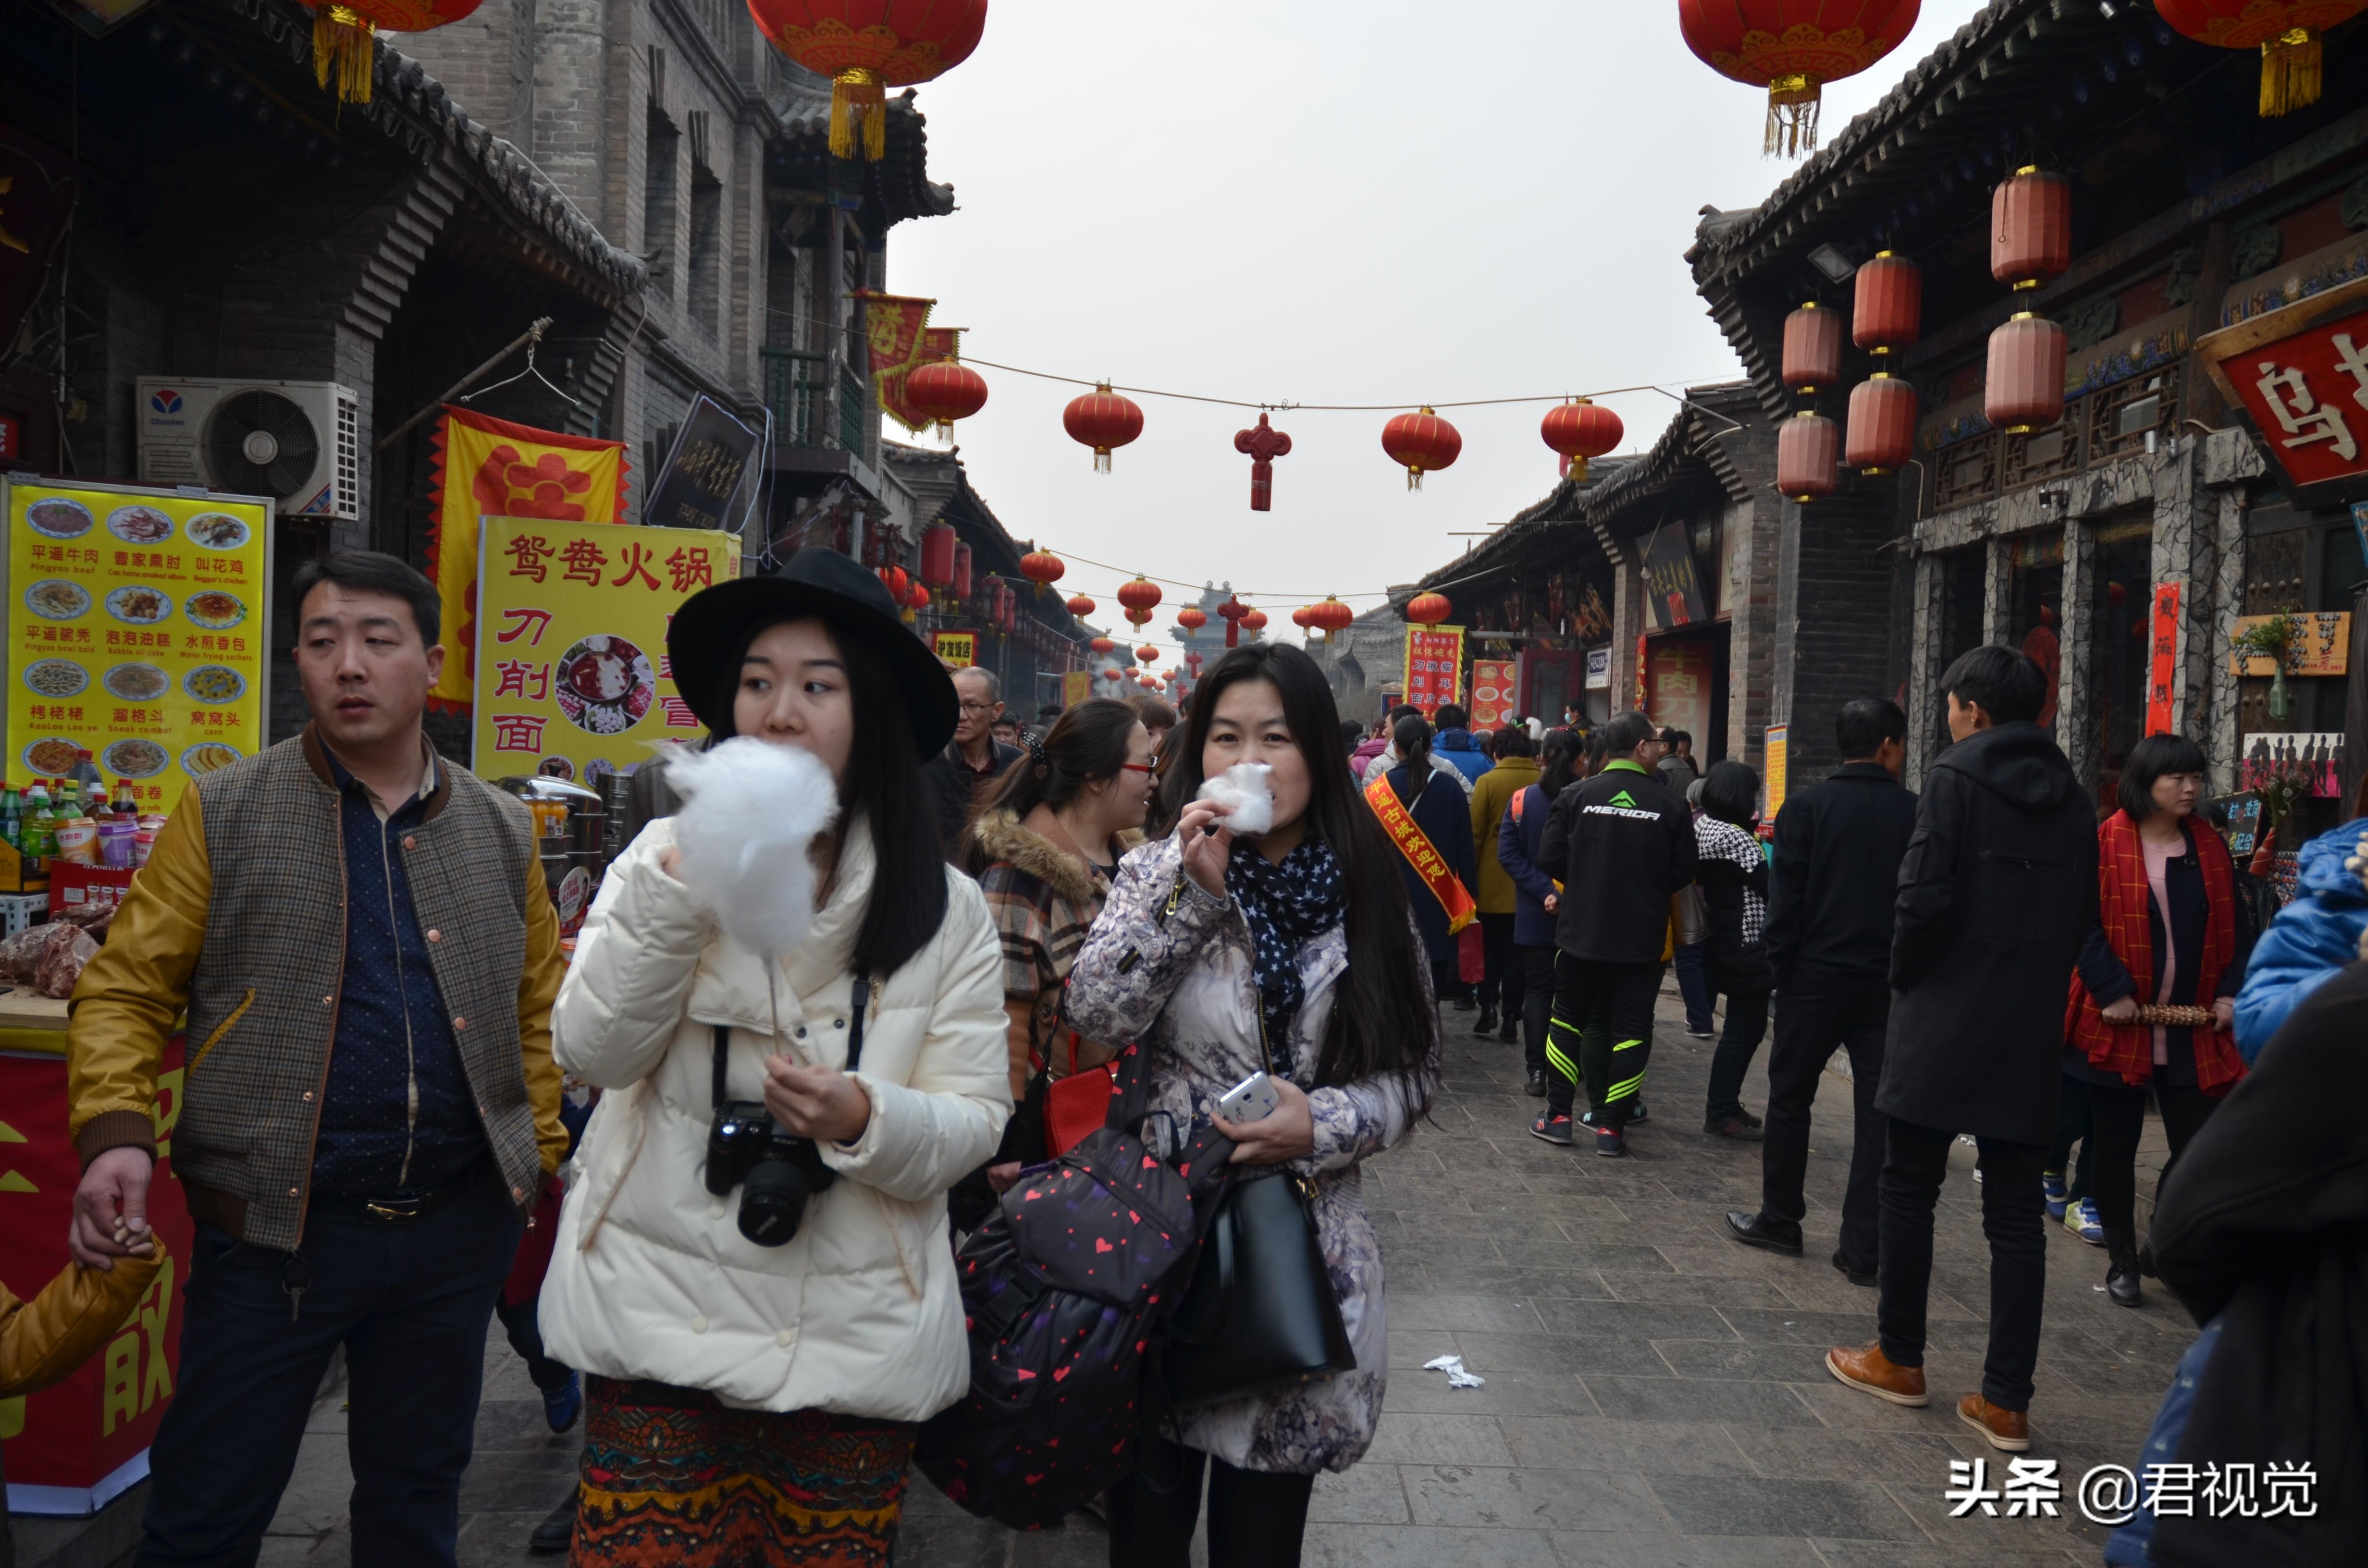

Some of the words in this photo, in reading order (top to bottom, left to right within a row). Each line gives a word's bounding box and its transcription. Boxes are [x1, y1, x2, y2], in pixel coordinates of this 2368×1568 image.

[32, 545, 99, 564] 平遥牛肉
[114, 551, 180, 569] 曹家熏肘
[31, 563, 70, 573] Pingyao
[74, 566, 96, 574] beef
[196, 558, 243, 574] 叫花鸡
[504, 534, 712, 593] 鸳鸯火锅
[26, 625, 91, 643] 平遥碗秃
[106, 630, 171, 647] 泡泡油糕
[185, 634, 245, 650] 水煎香包
[25, 643, 55, 652] Pingyao
[492, 609, 552, 754] 刀削面
[113, 708, 164, 723] 溜格斗
[191, 710, 240, 726] 窝窝头
[108, 724, 136, 733] Sneak
[1582, 805, 1661, 821] MERIDA
[1369, 780, 1446, 882] 平遥古城欢迎您
[772, 1137, 798, 1146] Nikon
